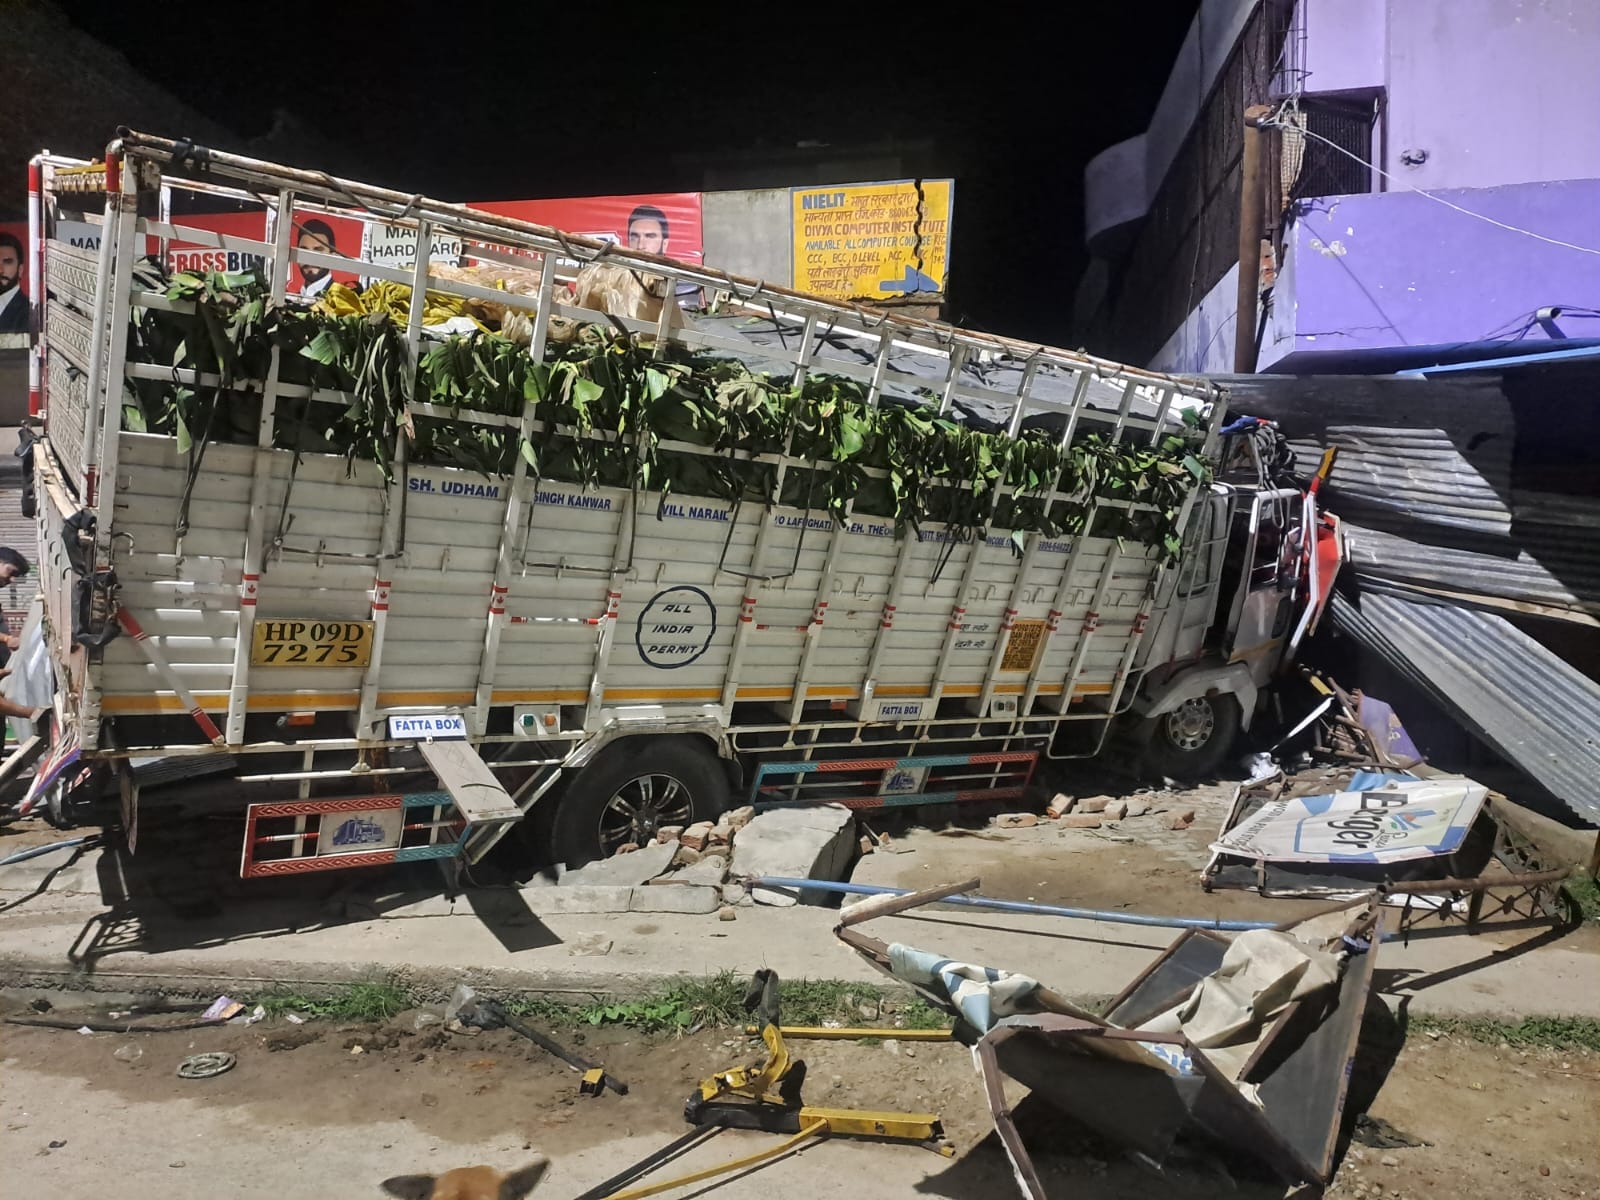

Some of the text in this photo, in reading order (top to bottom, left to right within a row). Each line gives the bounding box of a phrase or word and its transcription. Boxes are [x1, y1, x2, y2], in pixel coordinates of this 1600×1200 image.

[802, 193, 845, 209] NIELIT
[805, 220, 946, 237] DIVYA COMPUTER INSTTUTE
[805, 239, 841, 251] AVAILABLE
[845, 239, 857, 249] ALL
[857, 236, 898, 249] COMPUTER
[409, 477, 435, 492] SH.
[441, 481, 499, 498] UDHAM
[567, 494, 612, 510] KANWAR
[662, 504, 685, 517] VILL
[689, 507, 729, 520] NARAIL
[662, 604, 692, 613] ALL
[264, 622, 364, 641] HP 09D
[652, 625, 694, 634] INDIA
[264, 644, 359, 662] 7275
[647, 645, 699, 654] PERMIT
[882, 705, 919, 715] FATTA BOX
[395, 719, 461, 731] FATTA BOX
